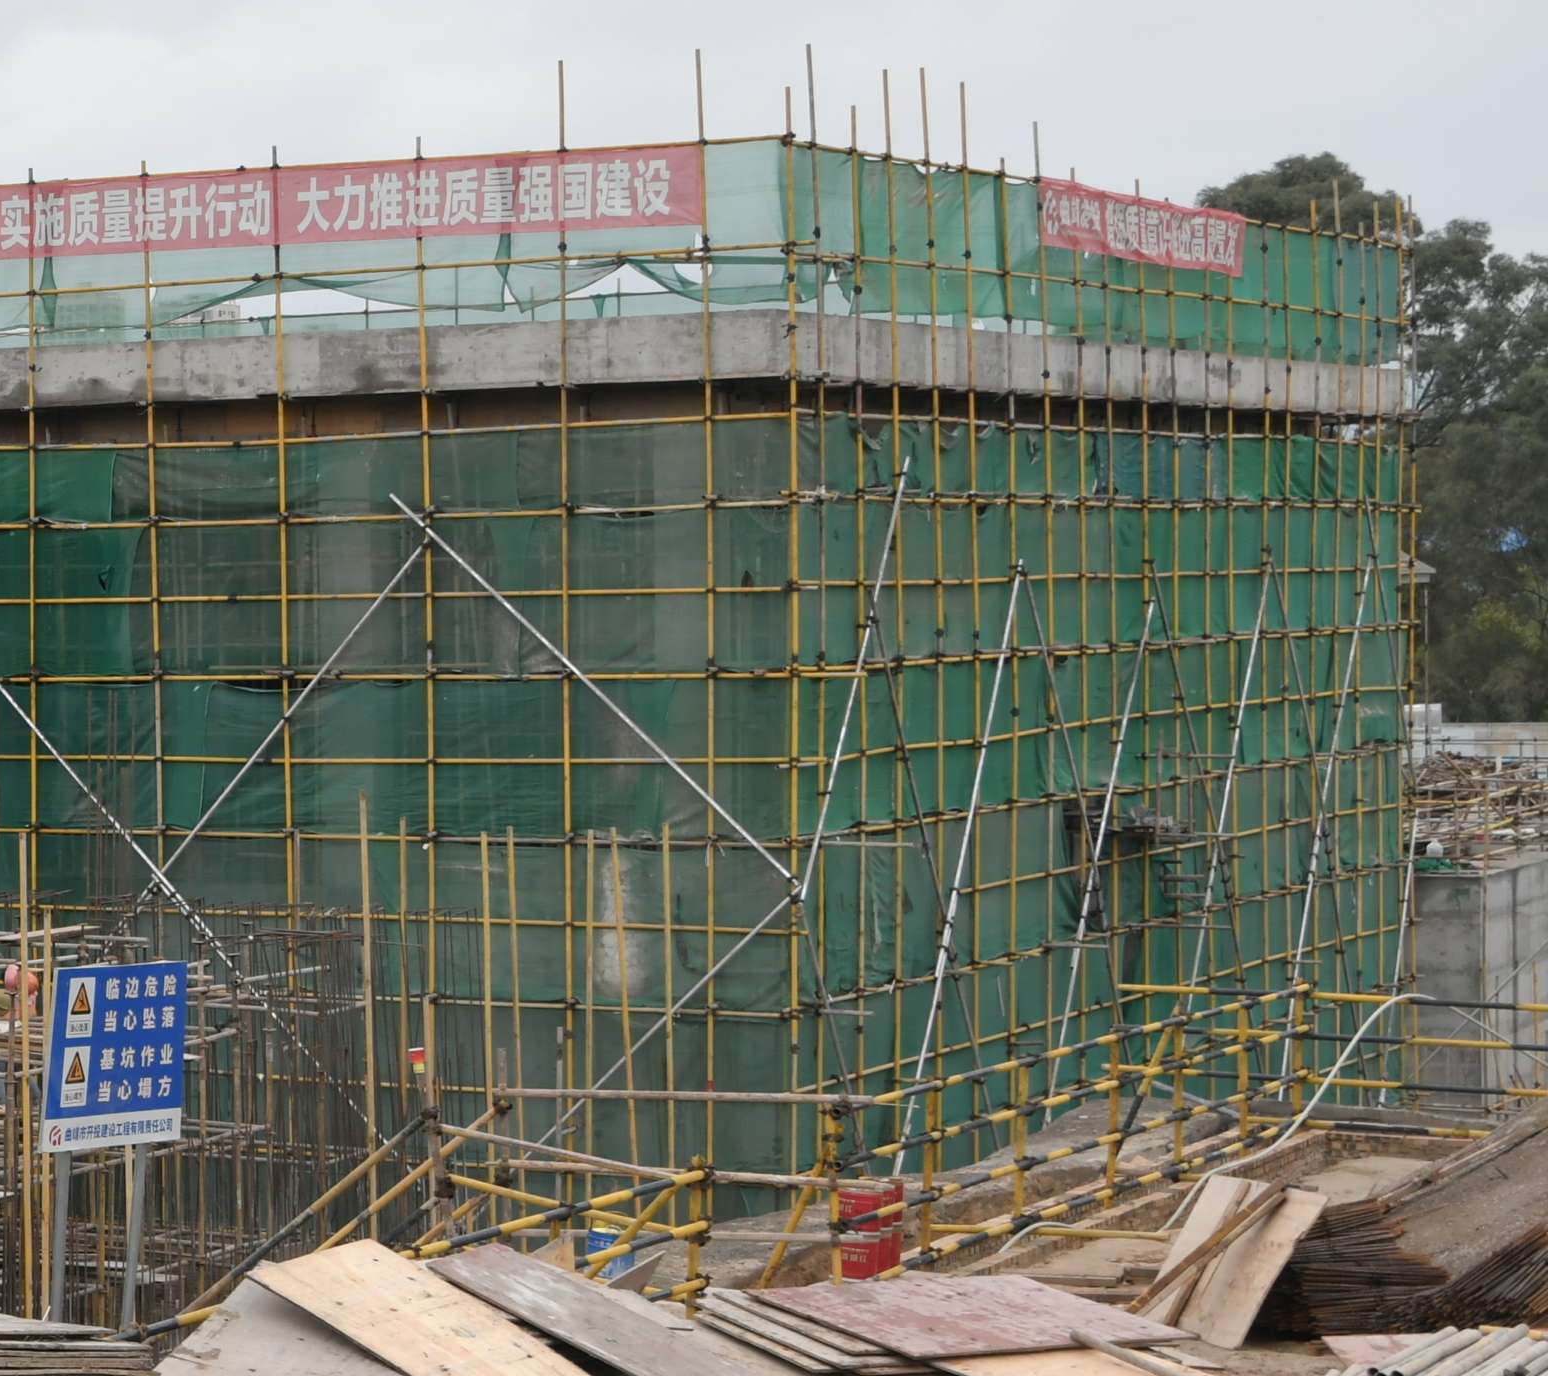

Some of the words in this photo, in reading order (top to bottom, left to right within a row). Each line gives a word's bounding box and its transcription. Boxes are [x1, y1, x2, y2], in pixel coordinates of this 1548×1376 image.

[297, 158, 672, 234] 大力推进质量强国建设
[106, 974, 178, 1001] 临边危险
[103, 1006, 176, 1033] 当心坠落
[99, 1043, 174, 1071] 基坑作业
[97, 1075, 173, 1103] 当心塌方
